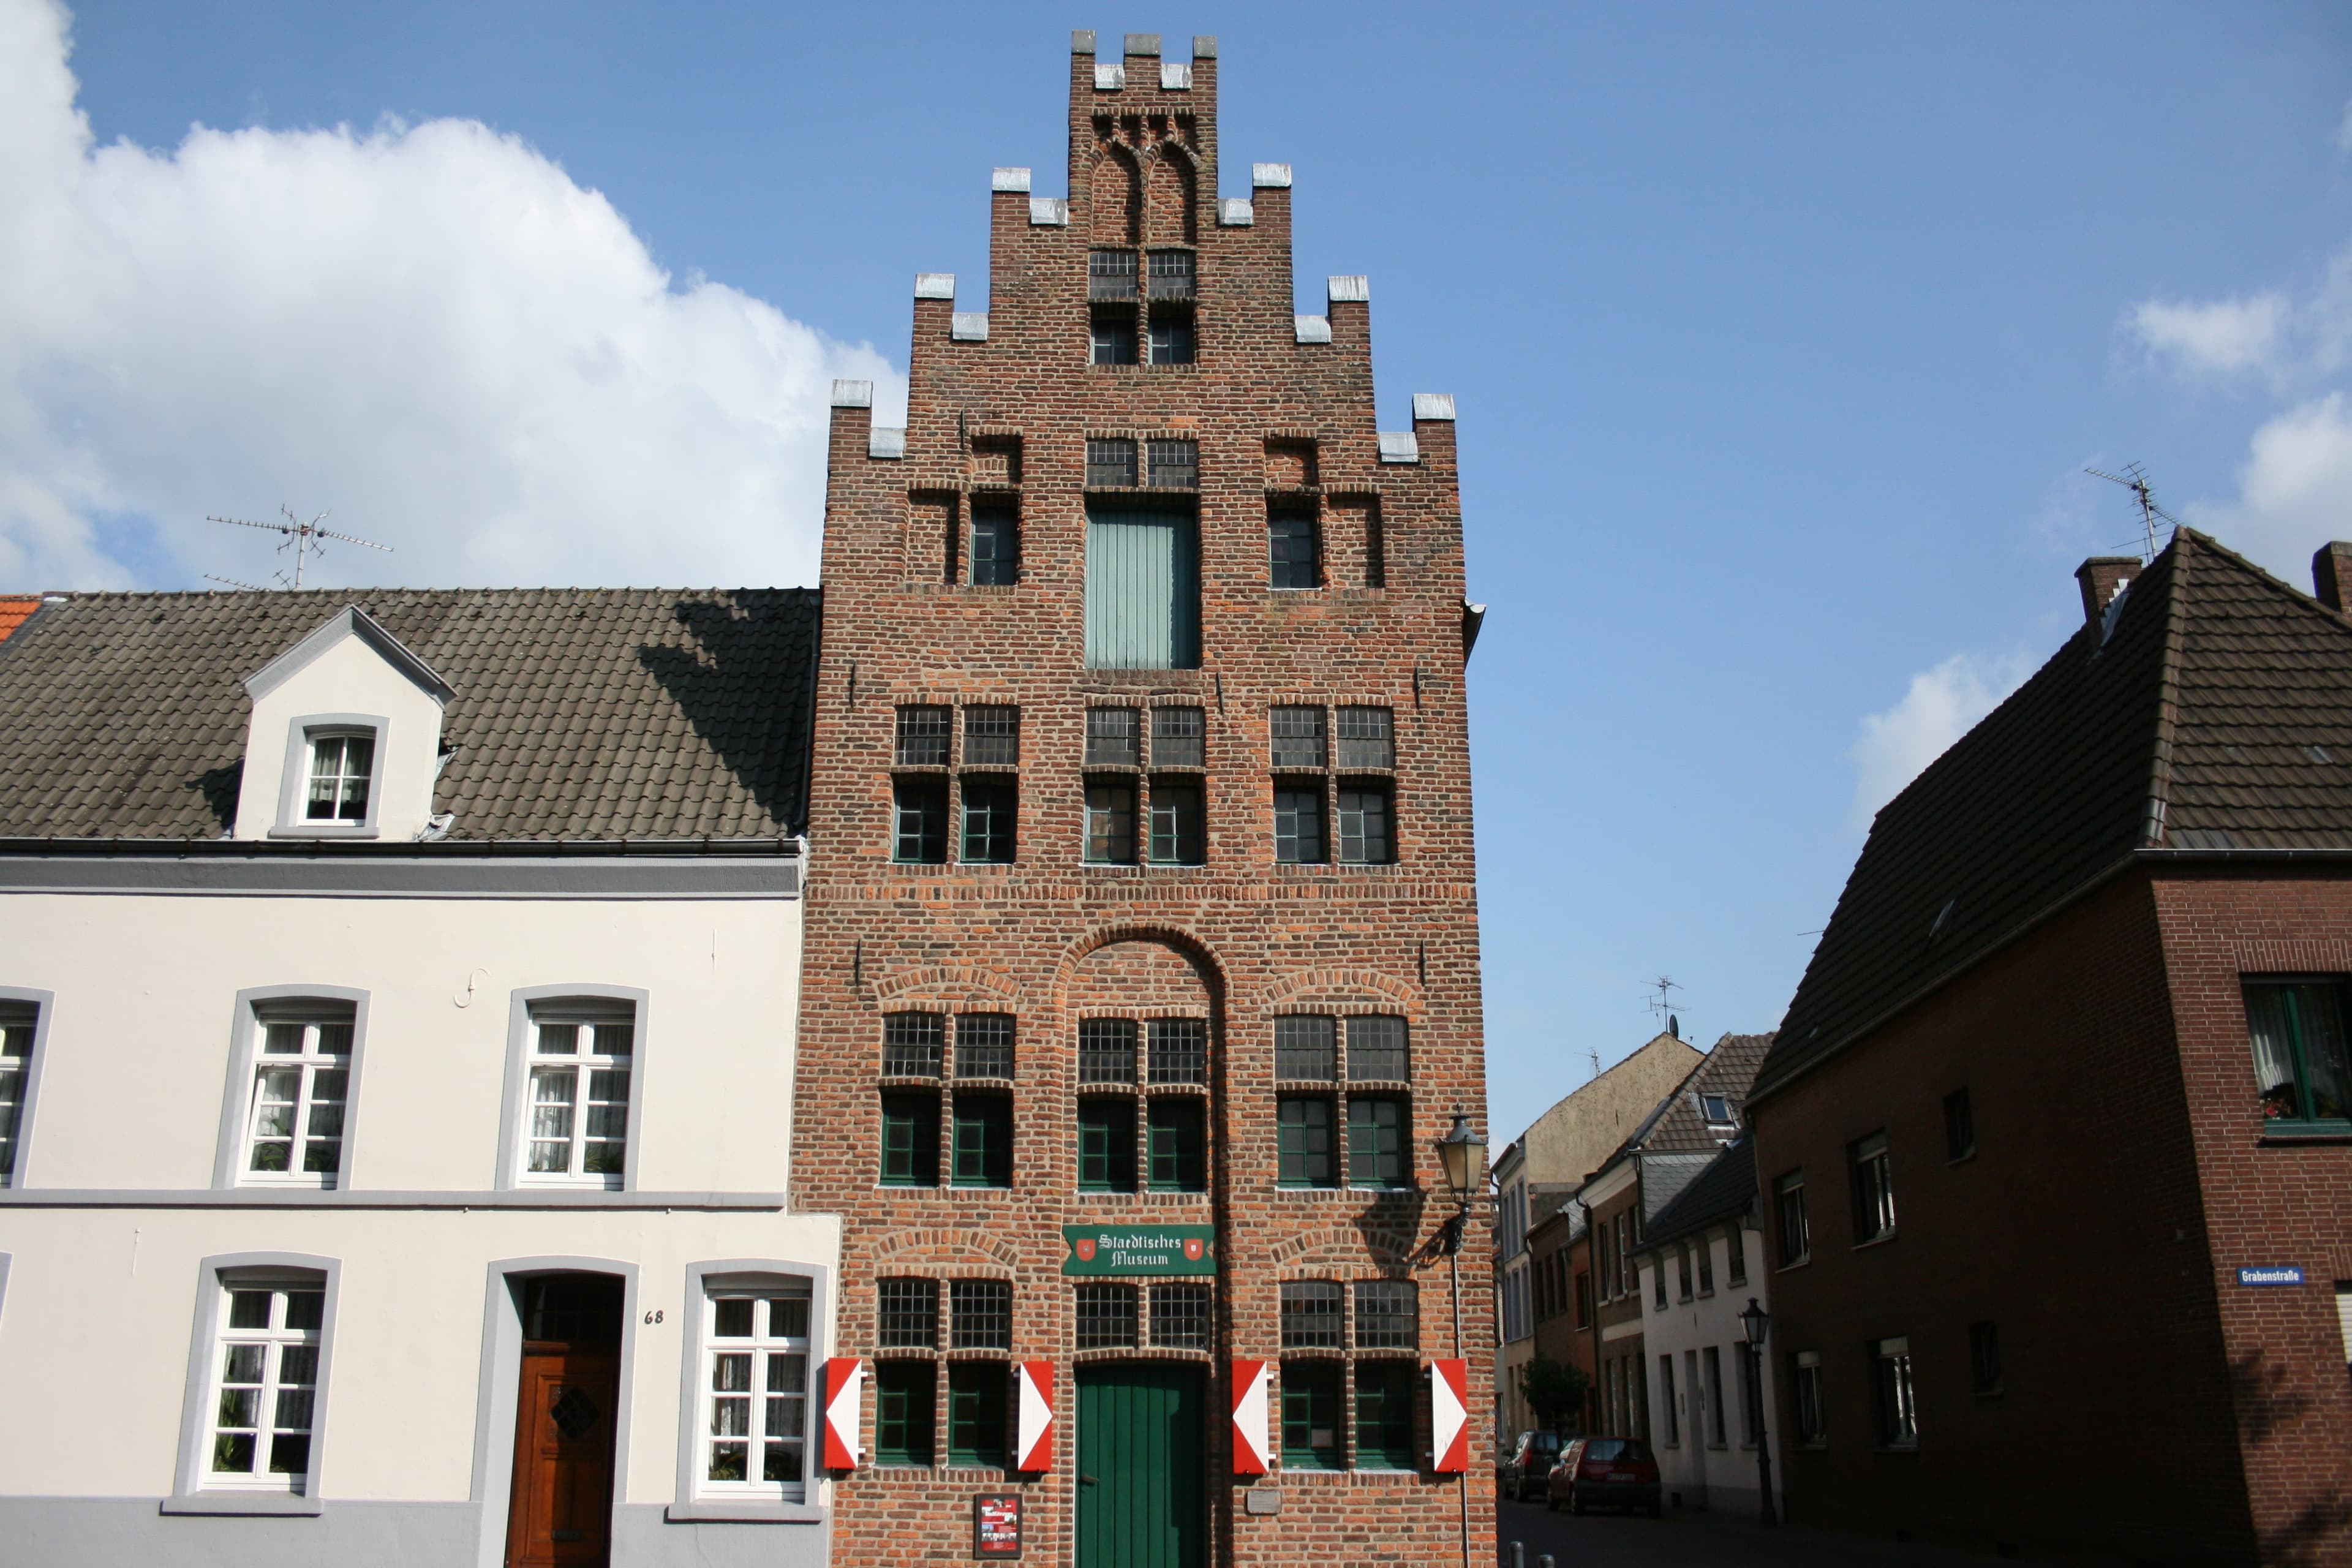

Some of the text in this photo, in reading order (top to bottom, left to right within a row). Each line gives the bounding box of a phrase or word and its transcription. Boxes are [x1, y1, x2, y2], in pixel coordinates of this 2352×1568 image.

[1099, 1234, 1181, 1249] Staedtisches
[1111, 1251, 1168, 1267] Museum
[2242, 1270, 2299, 1282] Grabenstraße
[644, 1310, 664, 1325] 68
